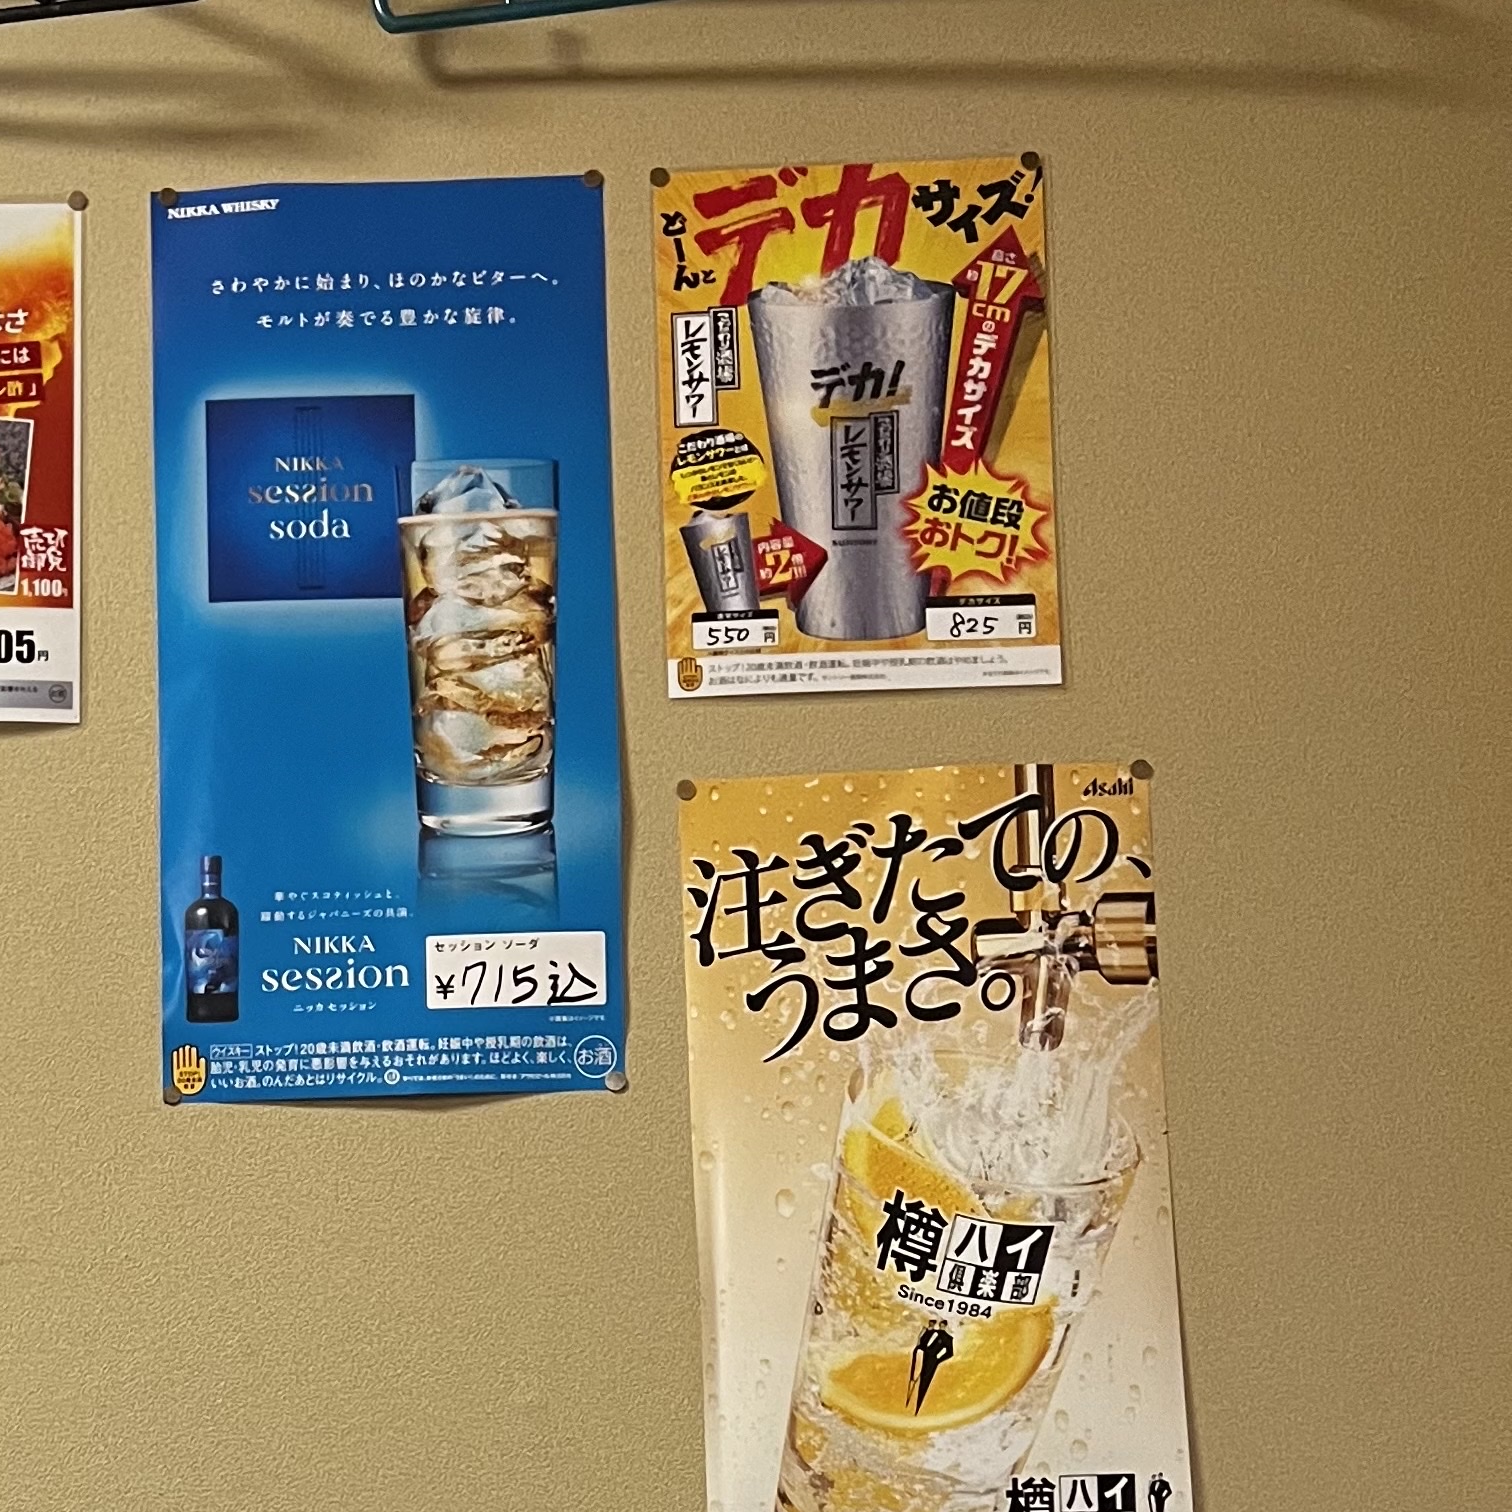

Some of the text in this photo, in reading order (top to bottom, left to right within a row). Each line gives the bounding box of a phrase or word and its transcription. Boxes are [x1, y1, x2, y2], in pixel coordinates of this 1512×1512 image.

[167, 198, 280, 220] NIKKA WHISKY
[210, 270, 559, 297] さわやかに始まり、ほのかなビターへ。
[255, 305, 517, 330] モルトが奏でる豊かな旋律。
[679, 319, 711, 419] レモンサワー
[273, 456, 345, 473] NIKKA
[839, 424, 869, 523] レモンサワー
[247, 475, 374, 505] session
[926, 482, 1026, 531] お値段
[268, 507, 352, 541] soda
[918, 517, 1021, 569] おトク!
[949, 611, 999, 638] 825
[1083, 776, 1134, 797] Asahi
[688, 792, 1154, 967] 注ぎたての、
[292, 934, 376, 955] NIKKA
[260, 957, 410, 993] session
[745, 878, 1017, 1063] うまさ。
[577, 1042, 613, 1066] お酒
